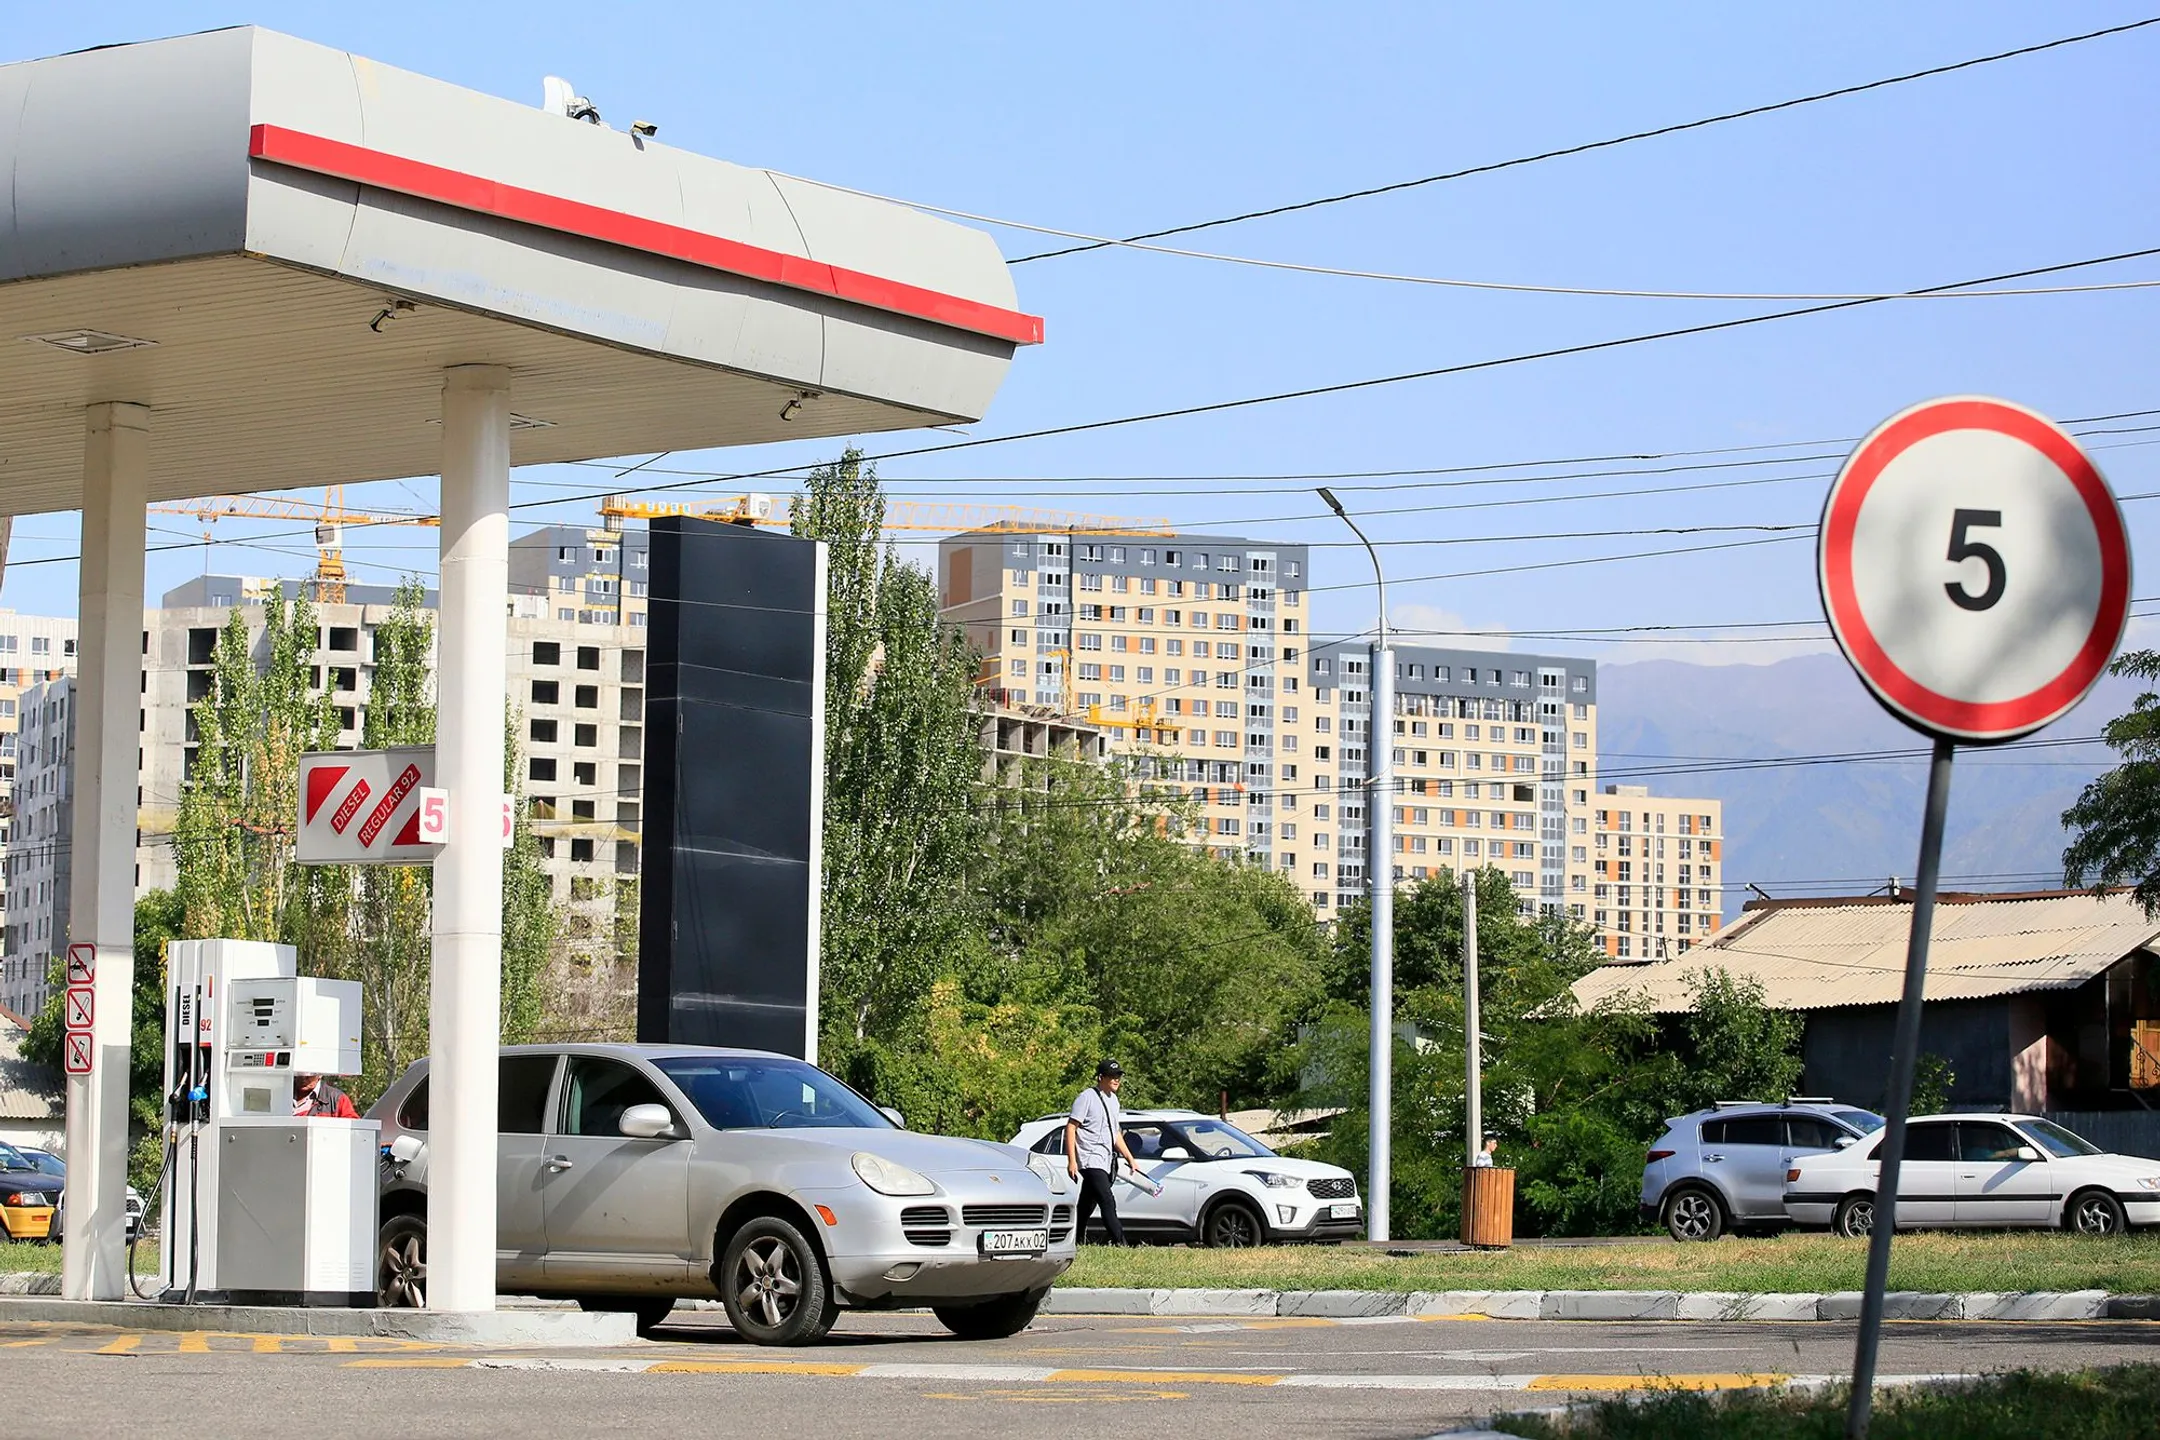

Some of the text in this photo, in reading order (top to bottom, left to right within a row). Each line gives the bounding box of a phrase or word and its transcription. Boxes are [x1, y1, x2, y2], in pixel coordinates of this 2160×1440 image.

[1944, 508, 2007, 612] 5
[333, 787, 367, 830] DIESEL
[360, 770, 417, 844] REGULAR 92
[424, 797, 444, 833] 5
[181, 993, 192, 1026] DIESEL
[200, 1018, 212, 1032] 92
